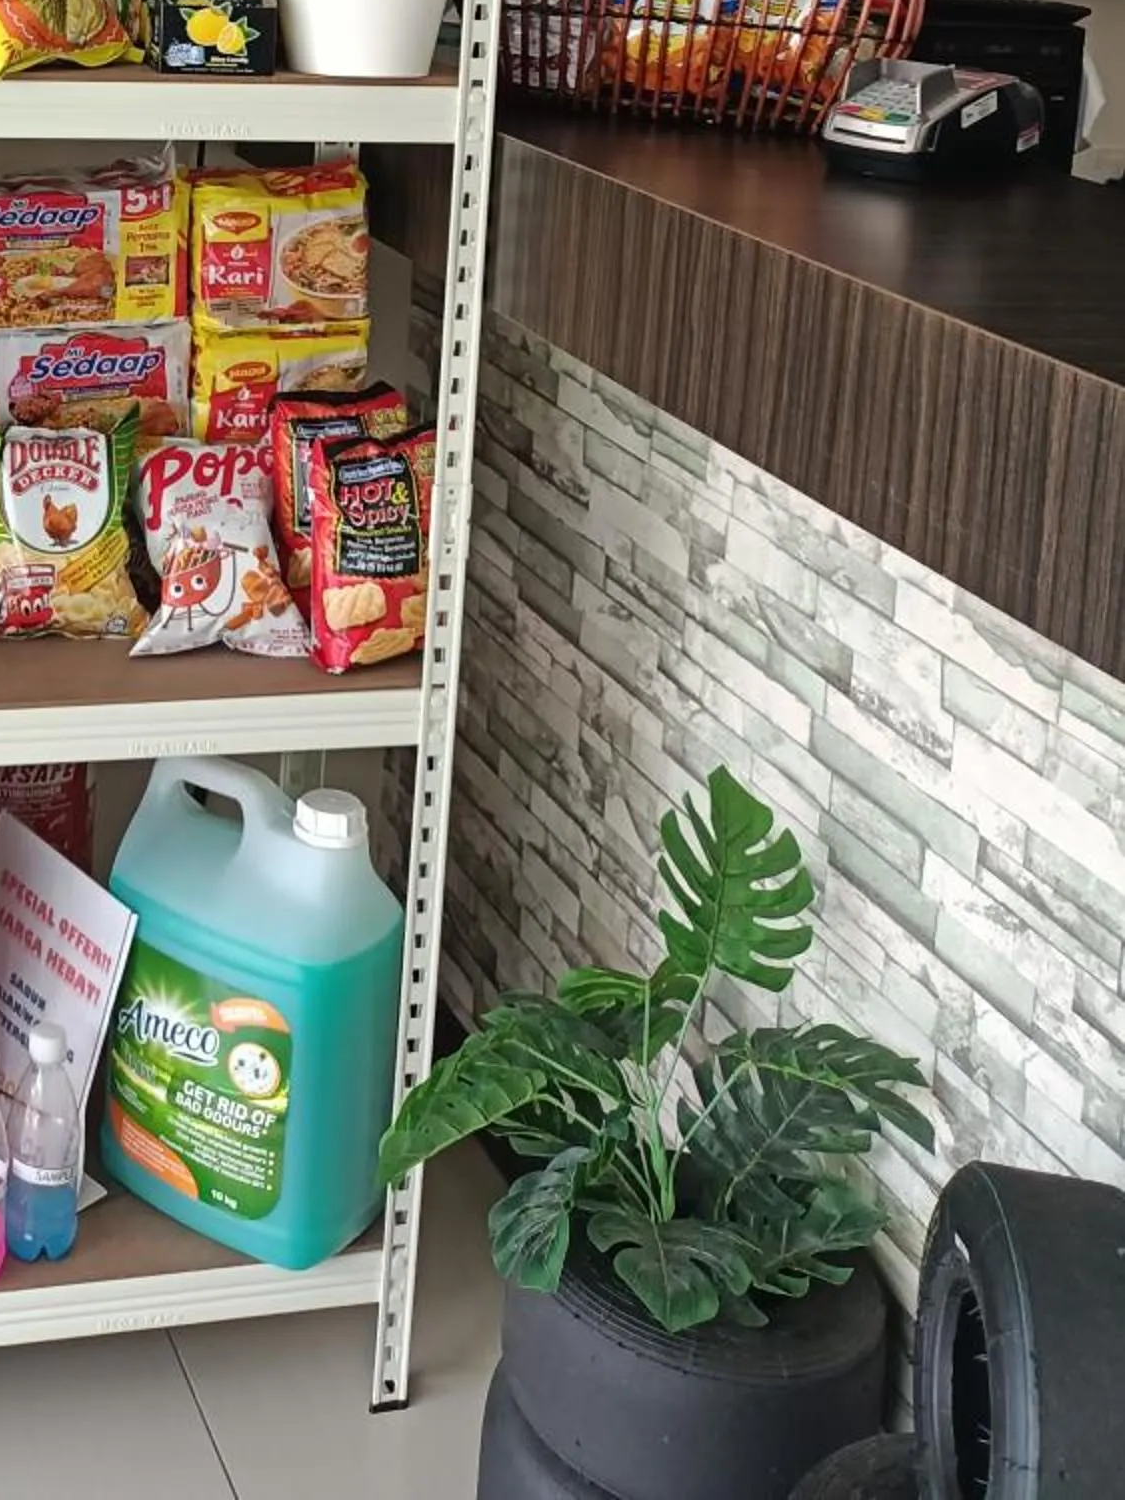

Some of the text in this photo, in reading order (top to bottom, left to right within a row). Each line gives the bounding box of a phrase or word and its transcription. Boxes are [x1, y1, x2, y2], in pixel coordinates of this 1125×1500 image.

[207, 264, 264, 286] Kari
[30, 352, 161, 380] Sedaap
[216, 410, 268, 429] Kari
[8, 434, 102, 478] DOUBLE
[15, 465, 93, 490] DECKER
[339, 477, 394, 506] HOT
[348, 502, 413, 529] Spicy
[0, 867, 55, 929] SPECIAL
[120, 998, 221, 1058] Ameco
[175, 1091, 202, 1114] BAD
[183, 1079, 277, 1128] GET RID OF
